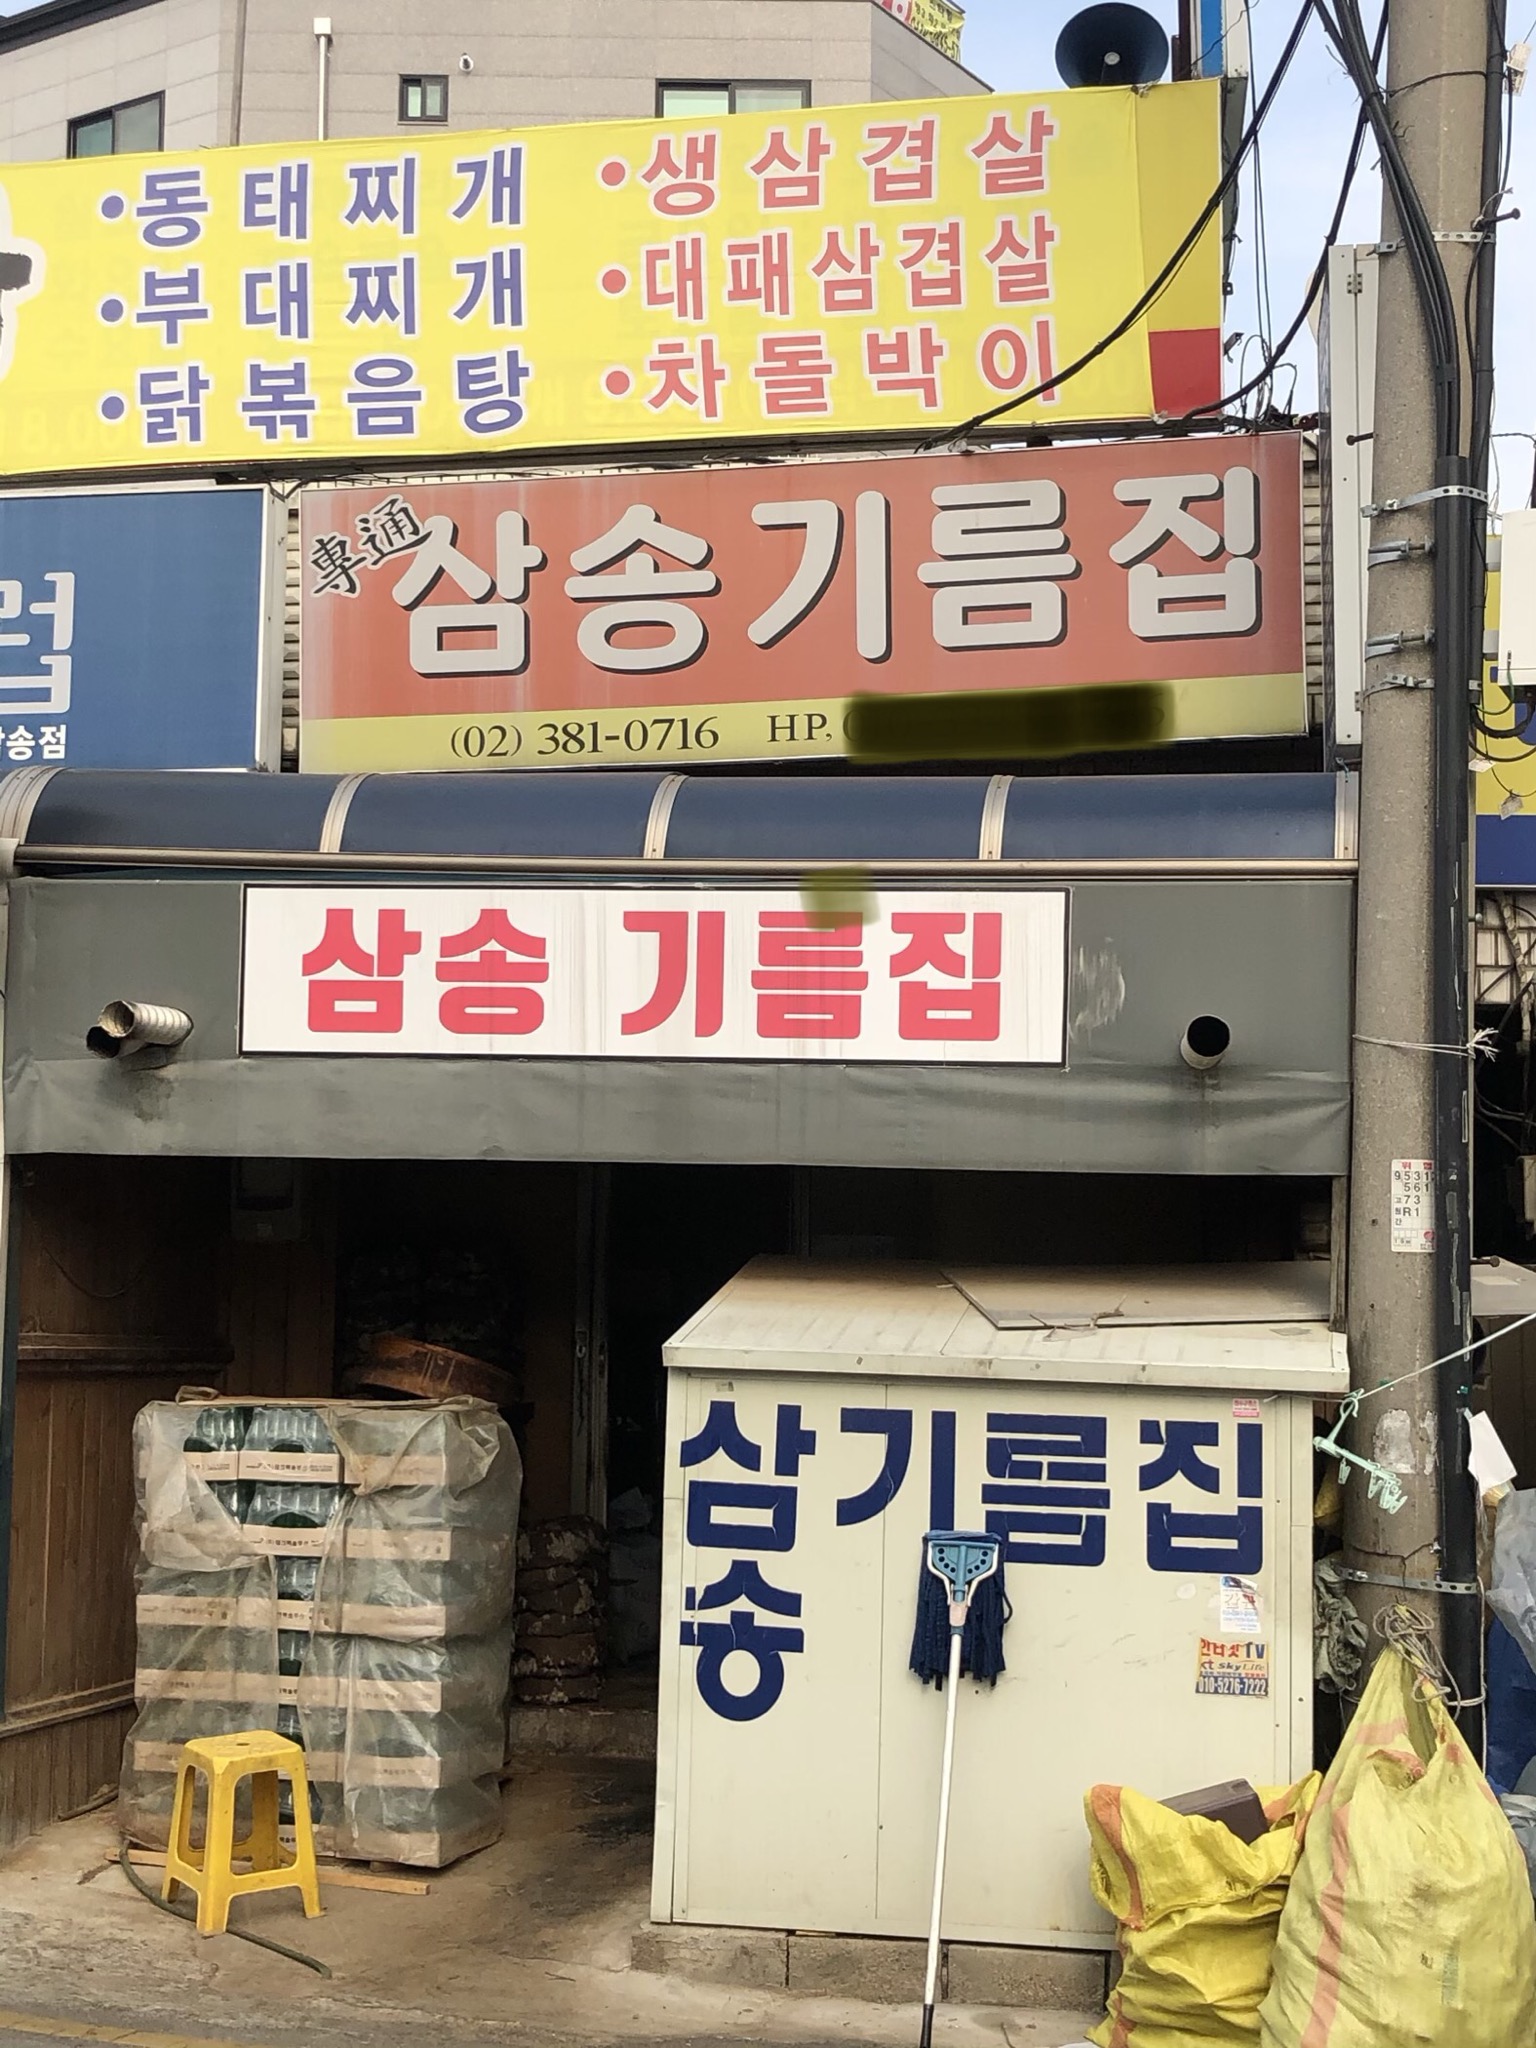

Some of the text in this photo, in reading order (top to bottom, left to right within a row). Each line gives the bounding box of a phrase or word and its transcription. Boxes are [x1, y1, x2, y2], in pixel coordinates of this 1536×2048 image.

[136, 146, 522, 247] 동태찌개
[643, 110, 1053, 215] 생삼겹살
[136, 248, 522, 344] 부대찌개
[646, 217, 1055, 319] 대패삼겹살
[139, 350, 530, 442] 닭볶음탕
[647, 320, 1056, 419] 차돌박이
[392, 465, 1262, 677] 삼송기름집
[0, 724, 67, 760] 송점
[451, 724, 522, 759] (02)
[537, 716, 720, 756] 381-0716
[301, 907, 1003, 1042] 삼송 기름집
[1403, 1182, 1430, 1193] 561
[1403, 1195, 1421, 1205] 73
[1197, 1676, 1267, 1696] 010-5276-7222
